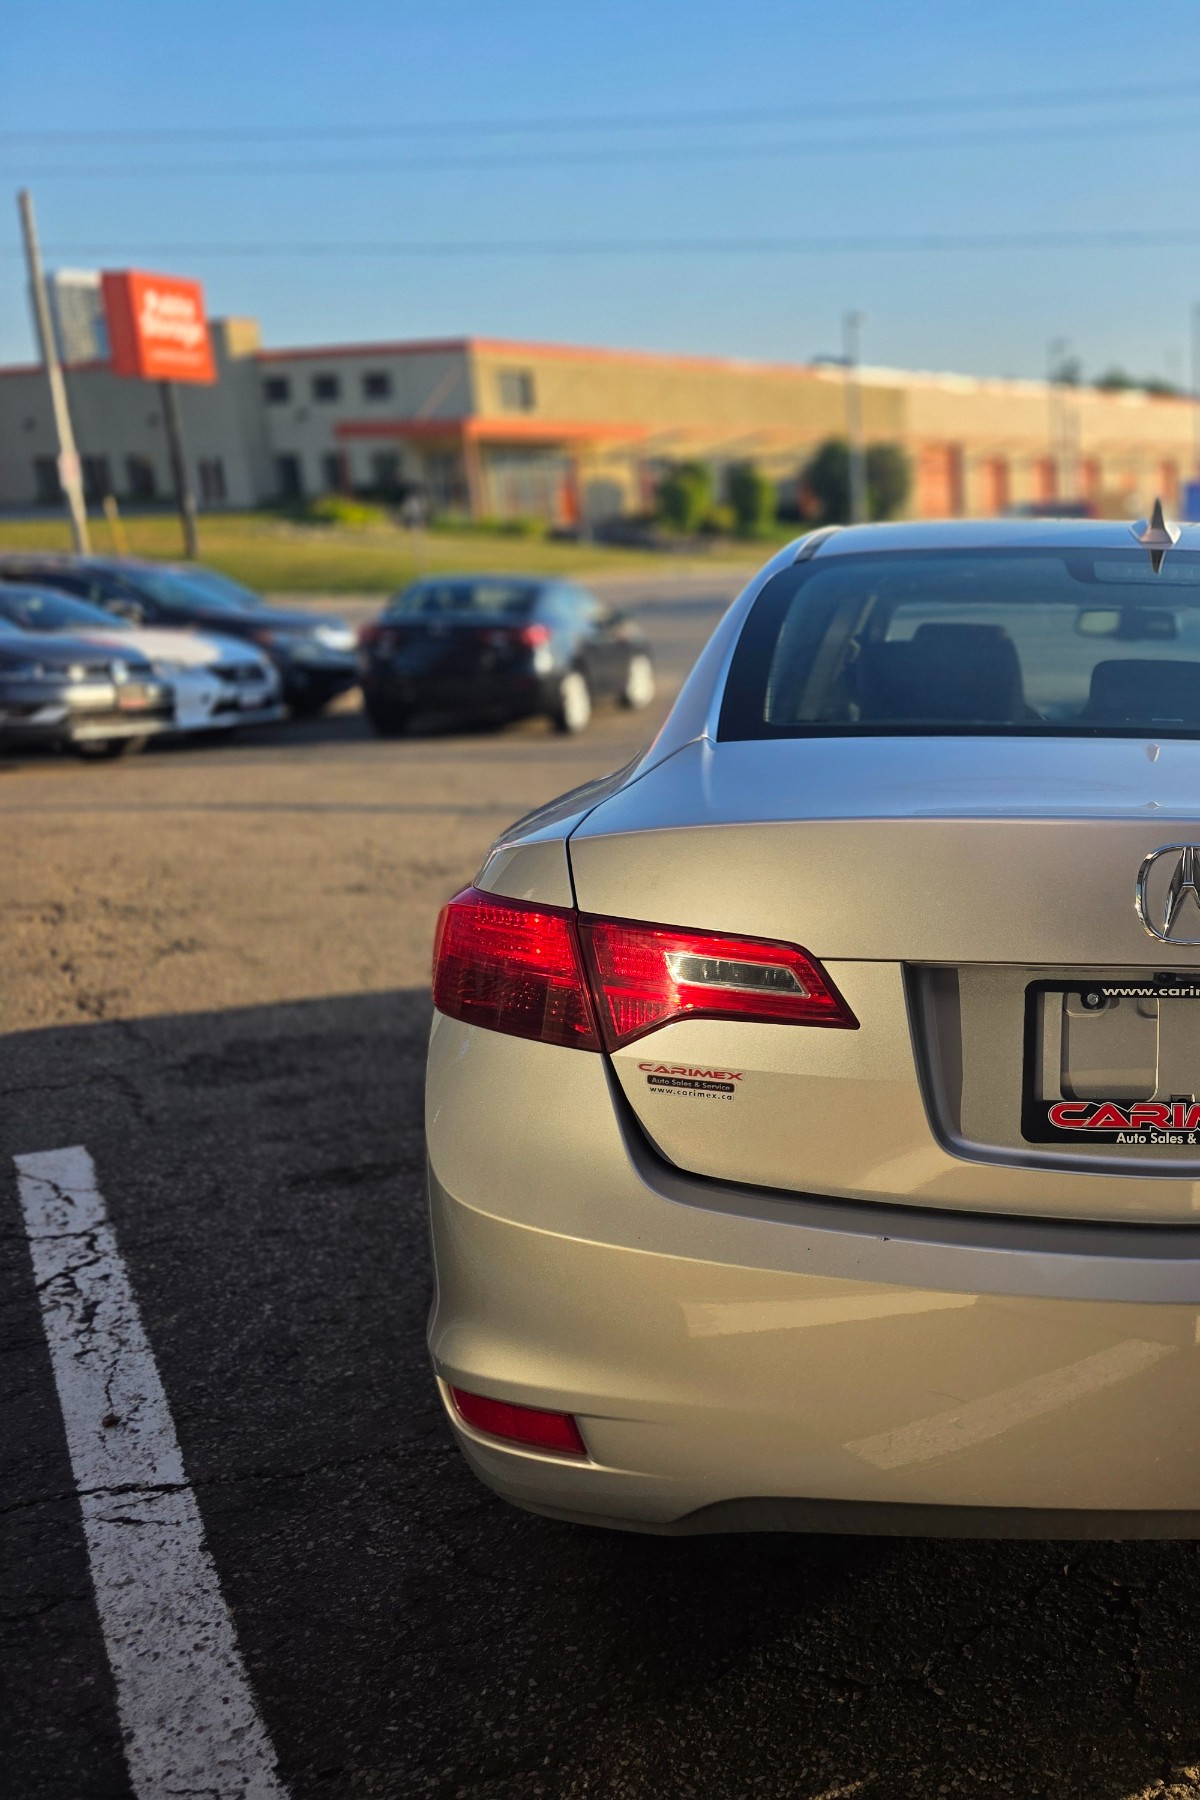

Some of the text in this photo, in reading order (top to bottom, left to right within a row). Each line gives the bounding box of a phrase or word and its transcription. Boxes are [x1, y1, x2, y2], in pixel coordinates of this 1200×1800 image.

[638, 1063, 744, 1081] CARIMEX
[651, 1077, 670, 1085] Auto
[671, 1079, 692, 1088] Sales
[702, 1083, 731, 1091] Service
[650, 1086, 732, 1101] www.carimex.ca
[1116, 1132, 1147, 1144] Auto
[1150, 1132, 1184, 1144] Sales
[1187, 1133, 1197, 1144] &
